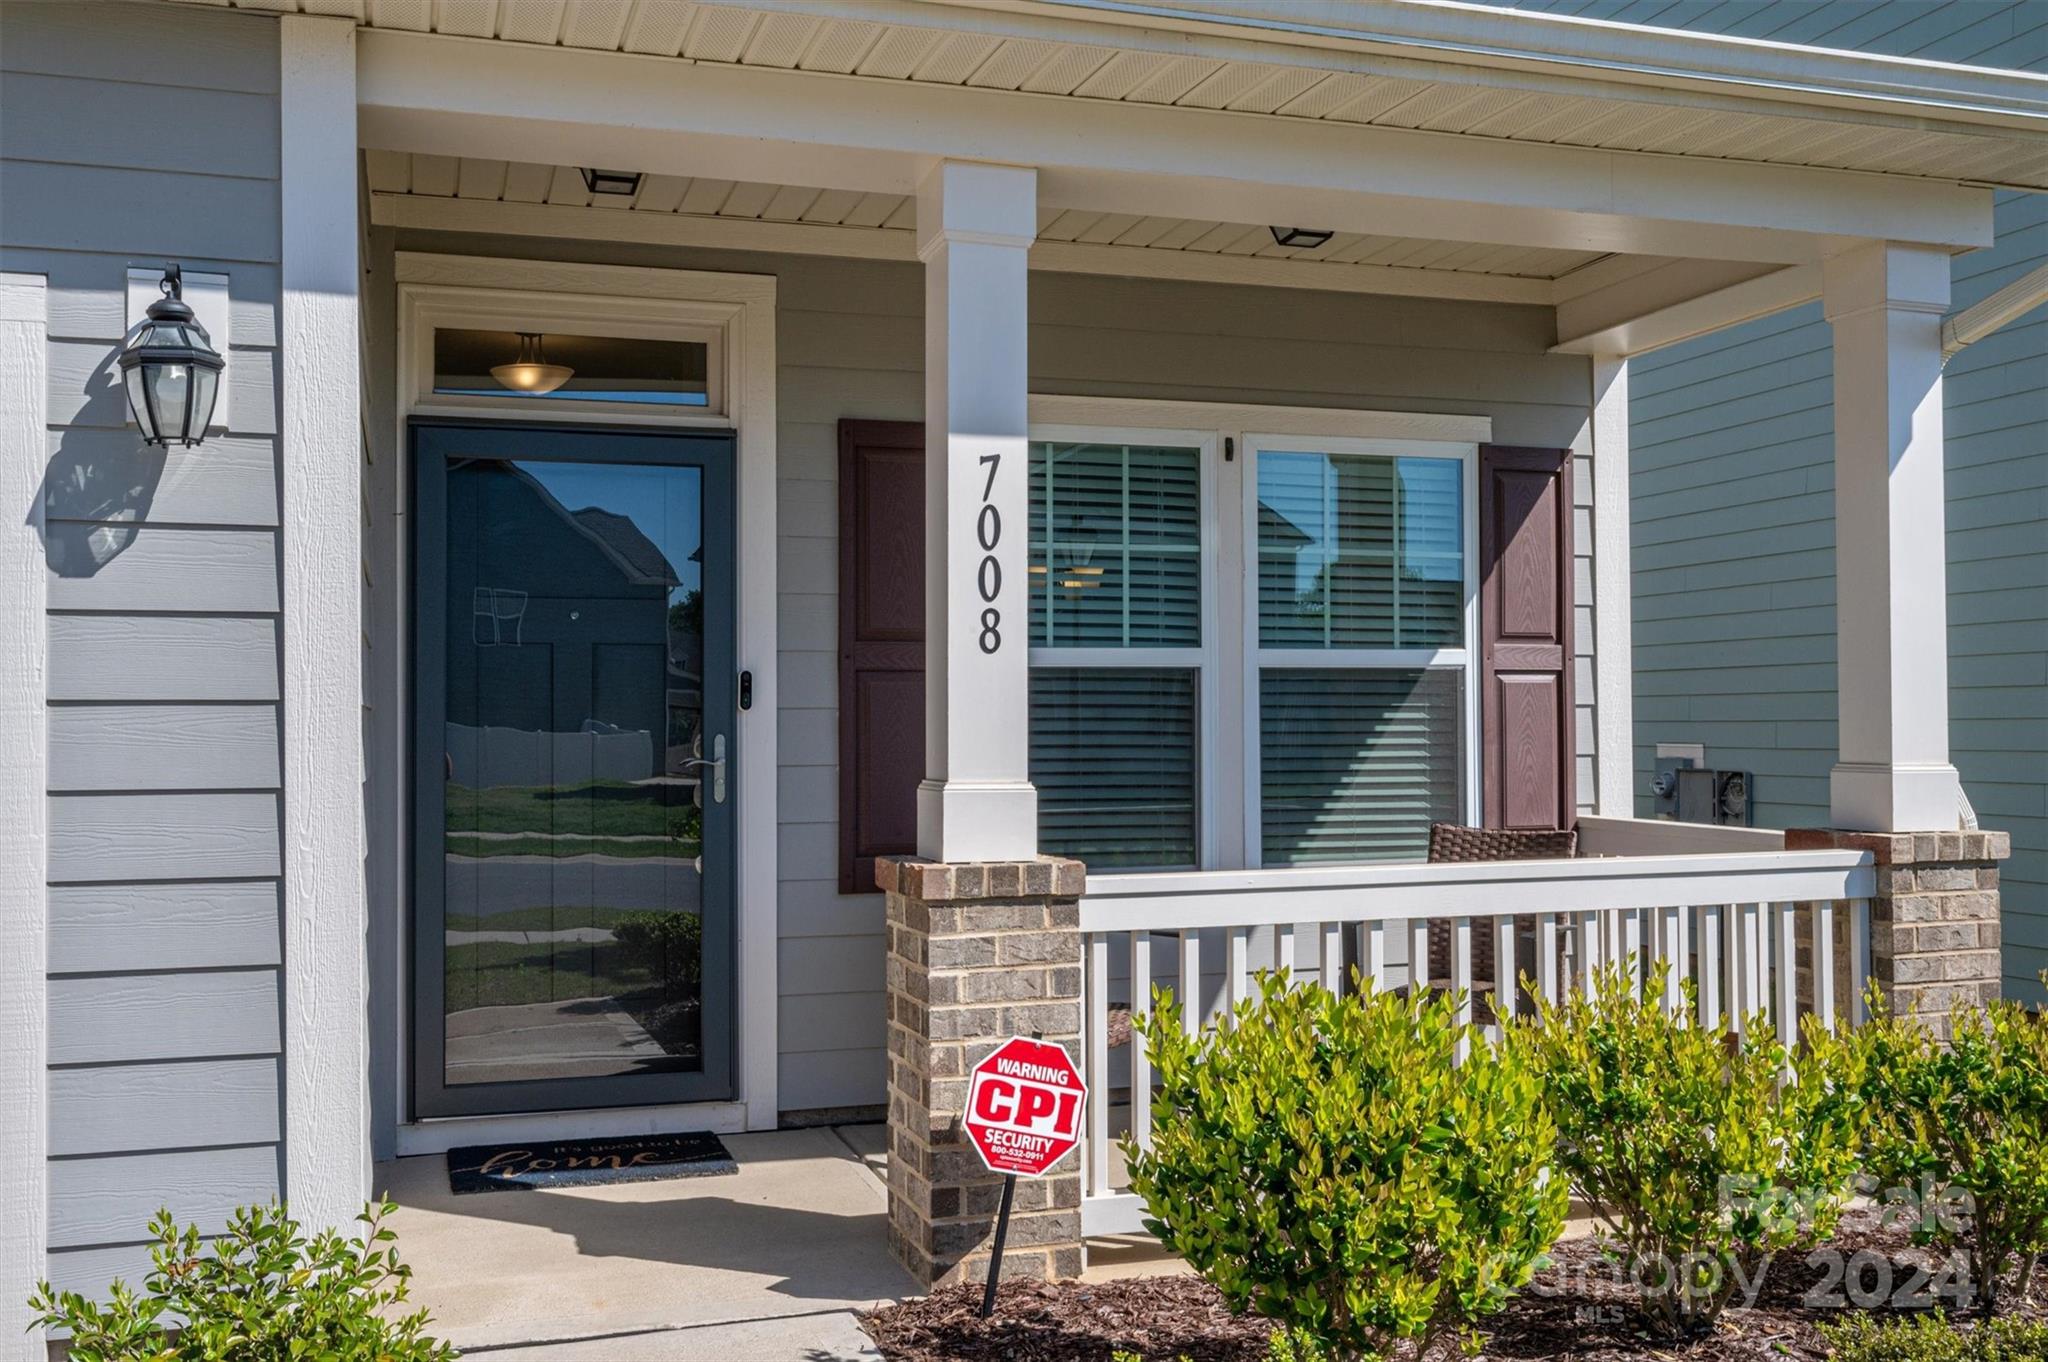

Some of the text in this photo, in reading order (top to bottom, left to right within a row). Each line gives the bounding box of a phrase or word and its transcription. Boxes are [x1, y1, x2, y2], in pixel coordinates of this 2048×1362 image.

[977, 454, 1002, 654] 7008
[997, 1058, 1069, 1085] WARNING
[975, 1079, 1078, 1134] CPI
[984, 1128, 1054, 1153] SECURITY
[991, 1145, 1044, 1160] 800-532-0911
[478, 1150, 672, 1178] home
